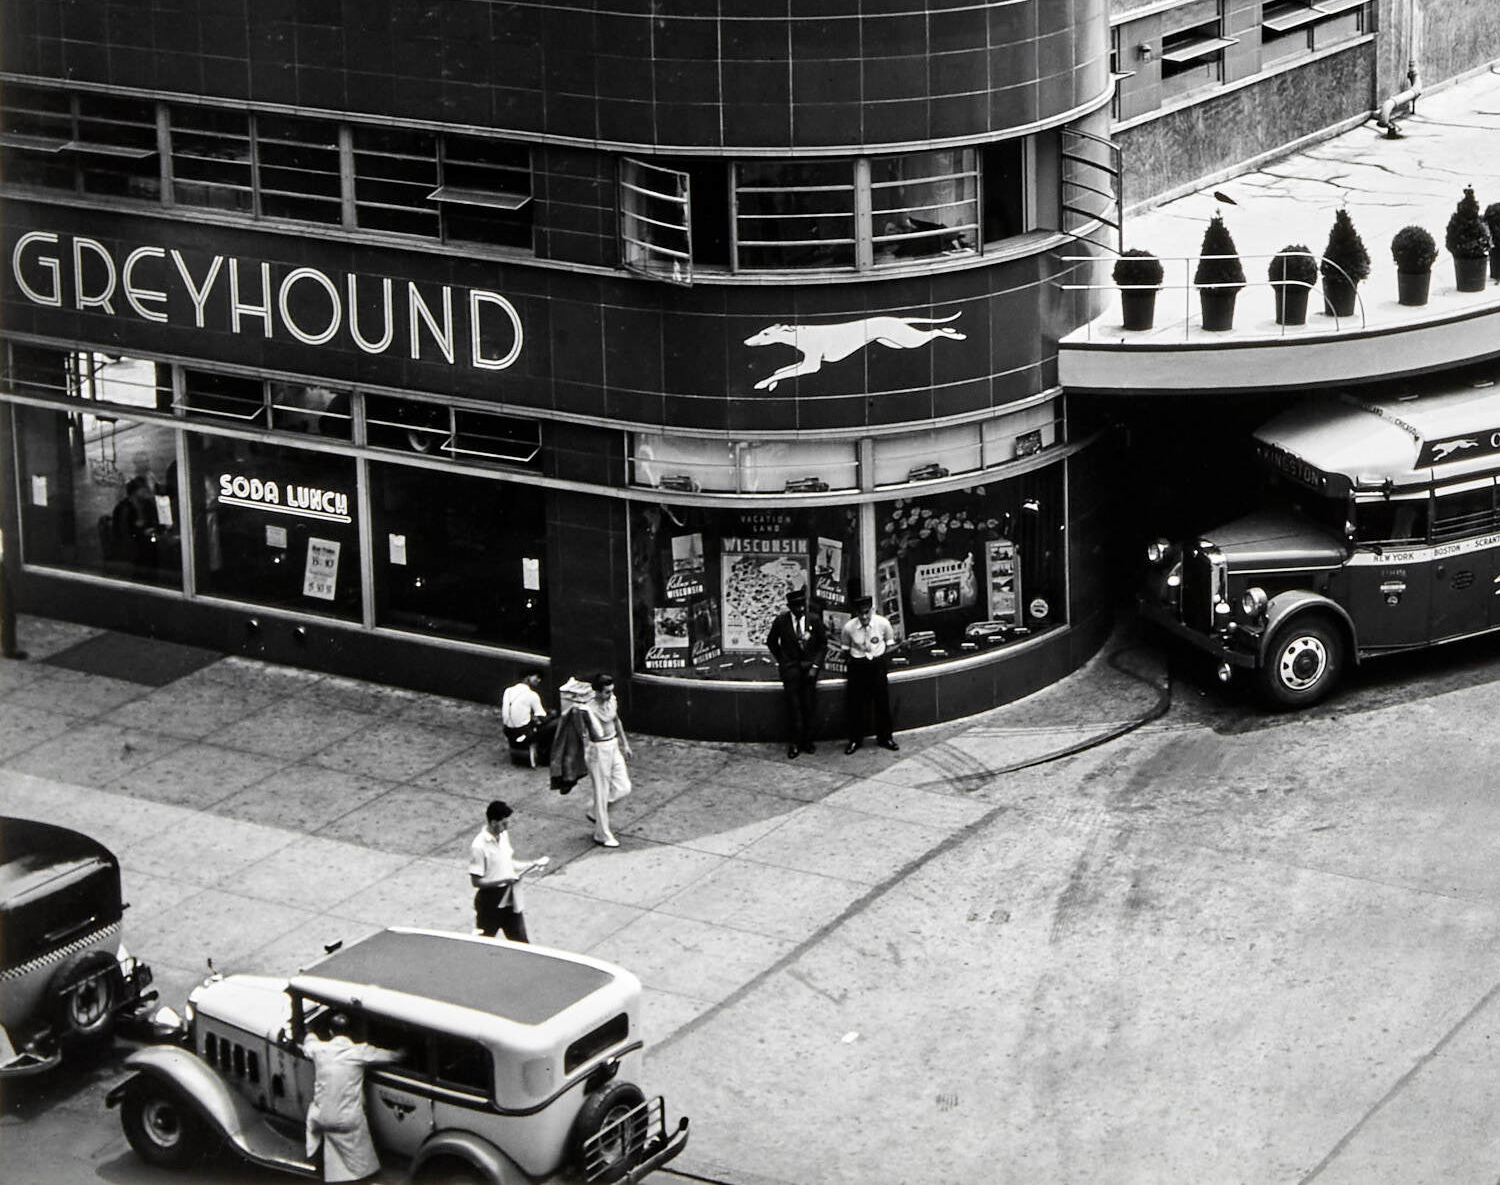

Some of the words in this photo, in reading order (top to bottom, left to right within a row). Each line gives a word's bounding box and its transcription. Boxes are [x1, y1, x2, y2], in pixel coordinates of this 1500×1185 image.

[12, 231, 524, 370] GREYHOUND
[219, 474, 279, 504] SODA
[287, 485, 348, 515] LUNCH
[723, 538, 807, 553] WISCONSIN
[1373, 553, 1390, 563] NEW
[1393, 552, 1414, 561] YORK
[1433, 544, 1461, 557] BOSTON
